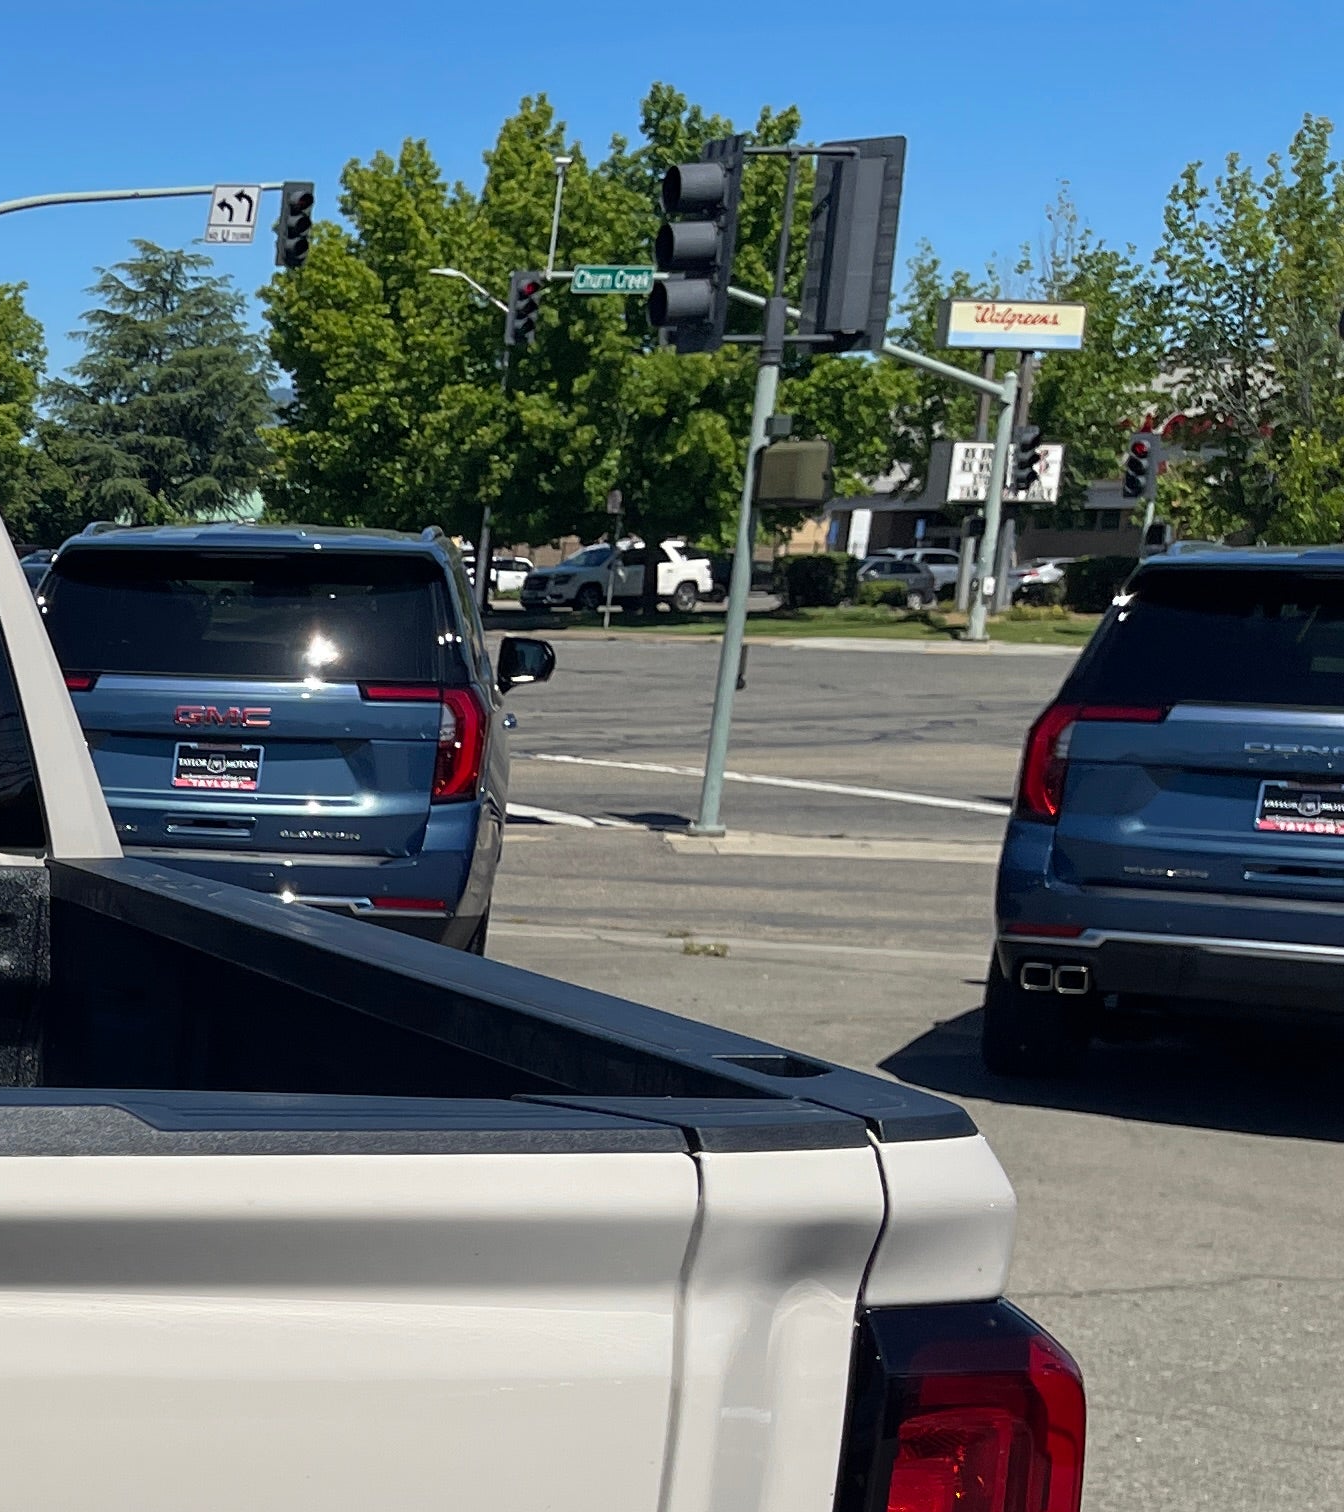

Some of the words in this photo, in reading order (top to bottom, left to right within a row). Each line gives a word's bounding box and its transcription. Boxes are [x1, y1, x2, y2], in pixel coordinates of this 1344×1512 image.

[221, 229, 230, 242] U
[575, 270, 612, 288] Churn
[614, 270, 650, 289] Creek
[975, 303, 1059, 331] Walgreens
[174, 705, 272, 728] GMC
[178, 758, 208, 768] TAYLOR
[226, 760, 258, 769] MOTORS
